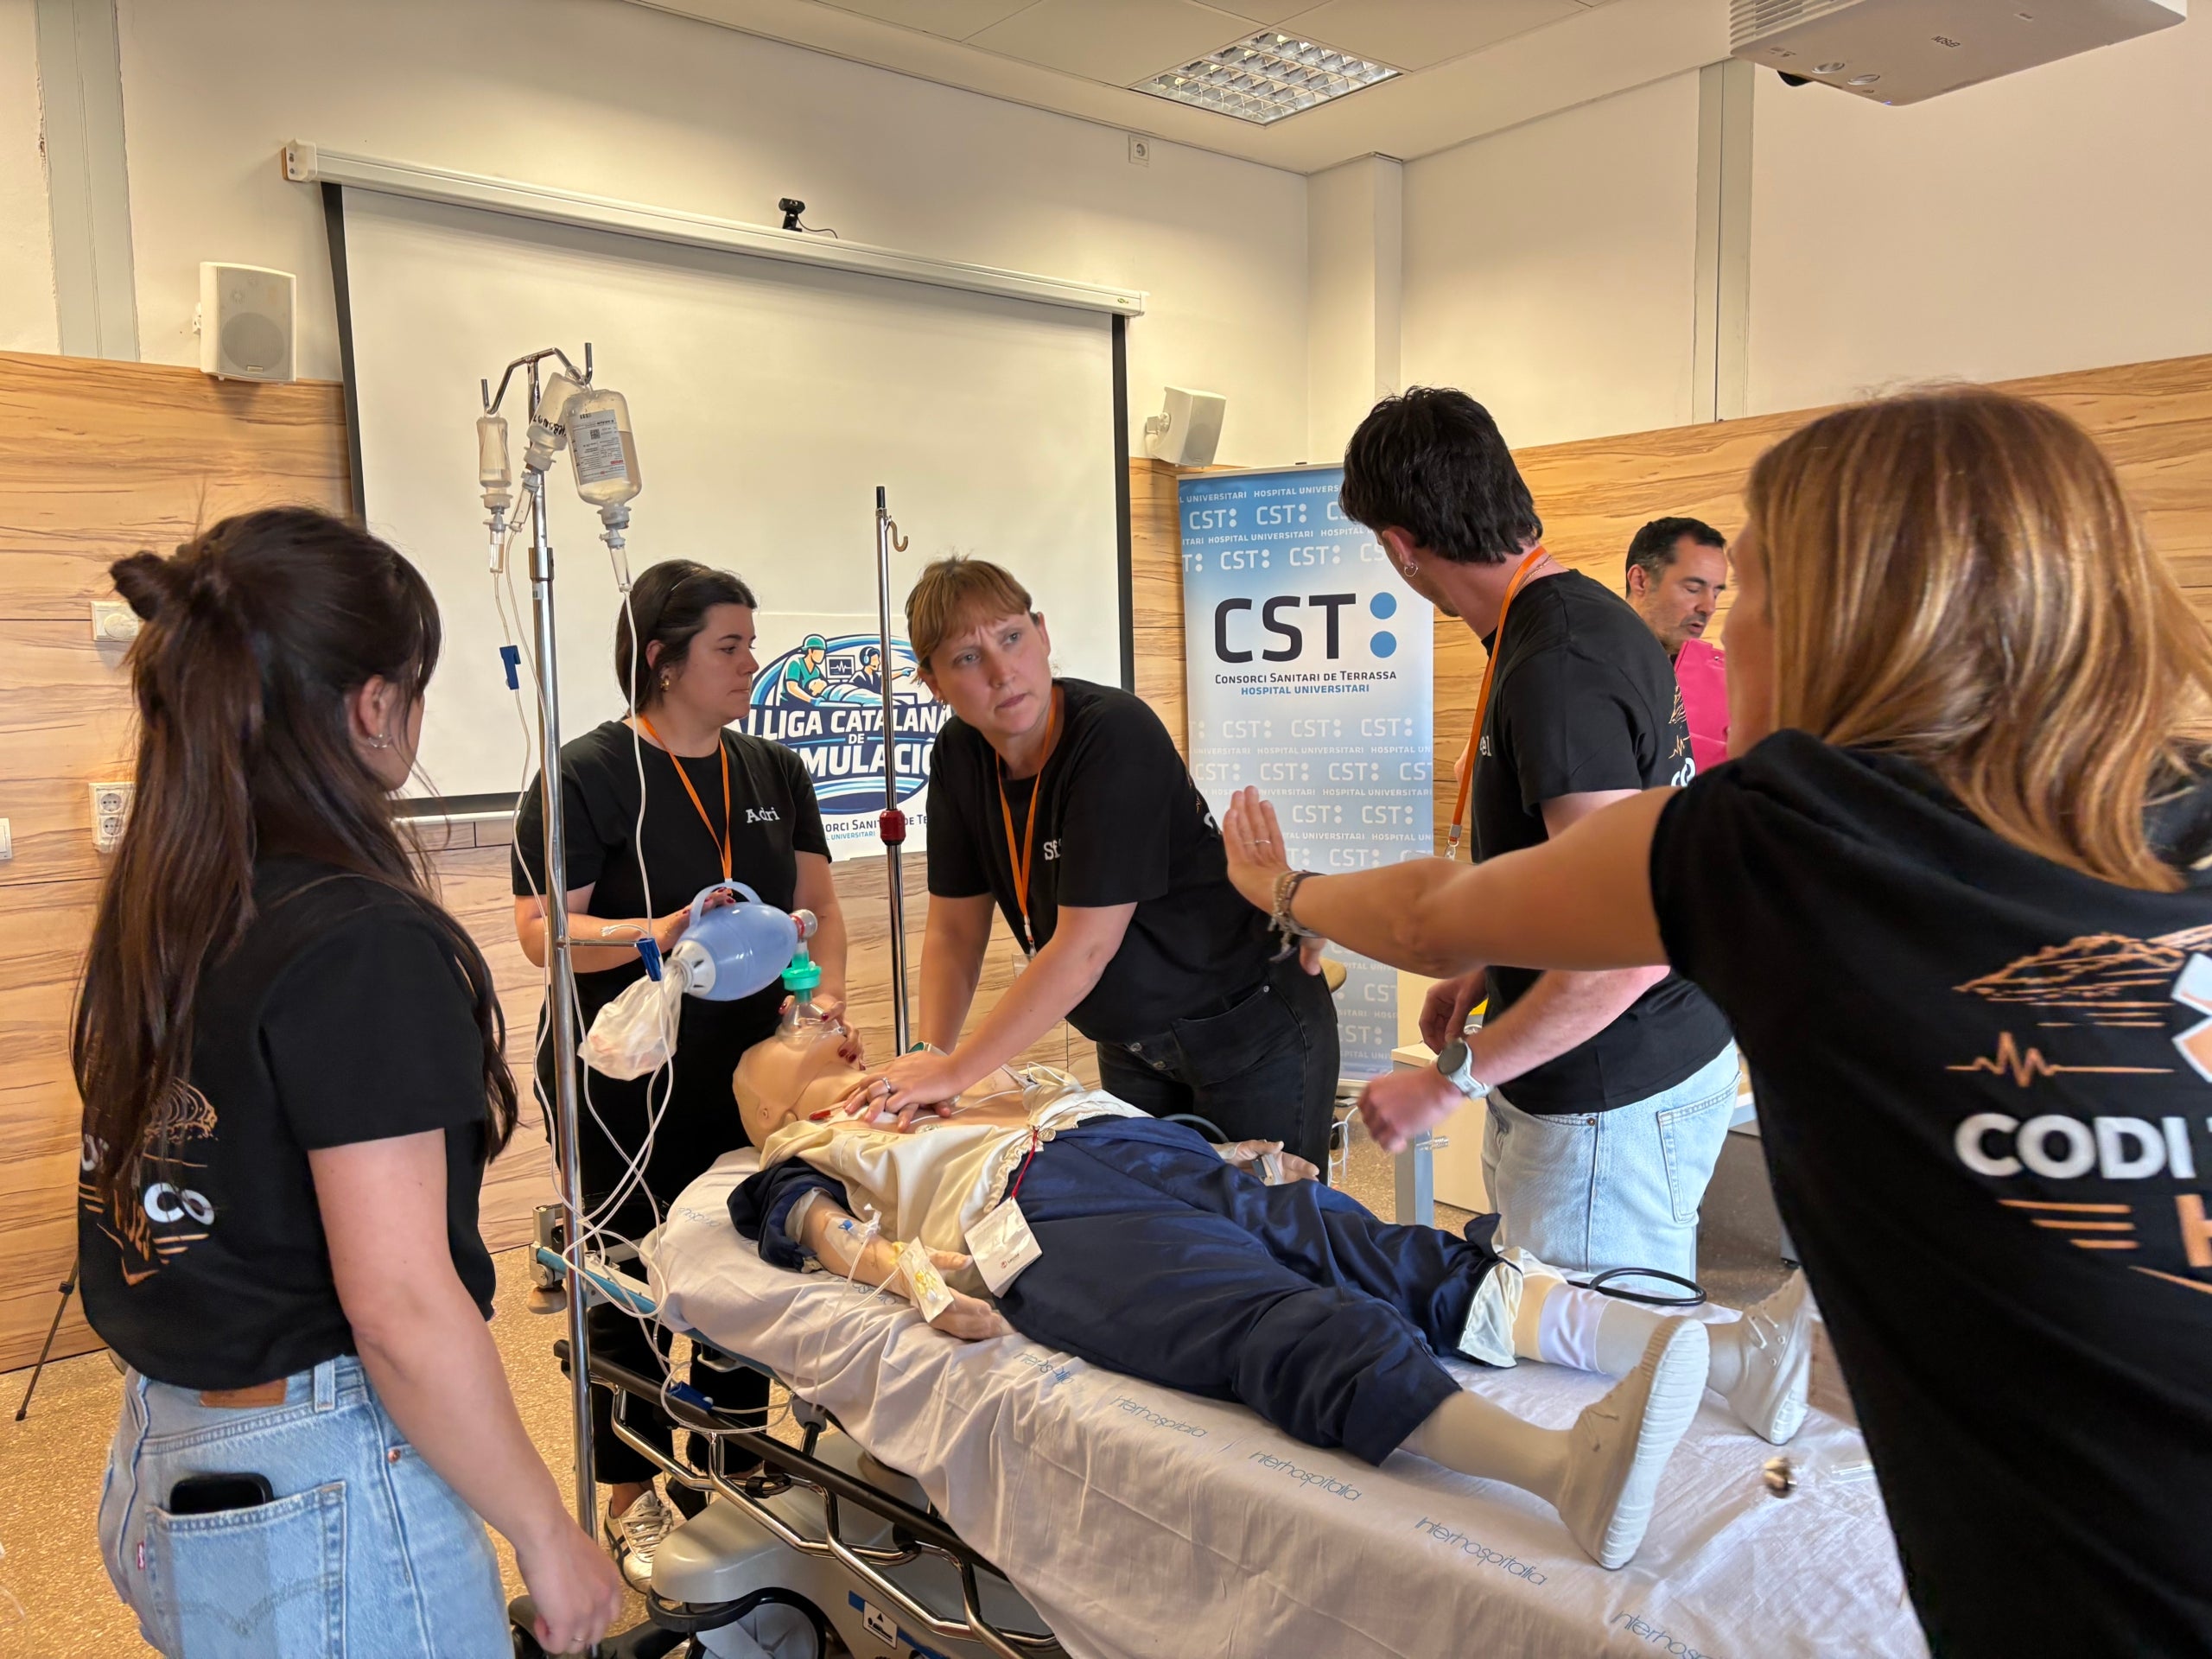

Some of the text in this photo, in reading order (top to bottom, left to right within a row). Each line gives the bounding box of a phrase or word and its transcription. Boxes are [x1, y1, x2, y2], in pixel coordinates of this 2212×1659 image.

[1187, 492, 1247, 502] UNIVERSITARI
[1254, 488, 1296, 498] HOSPITAL
[1299, 485, 1339, 494] UNIVERS
[1208, 535, 1249, 544] HOSPITAL
[1250, 531, 1313, 542] UNIVERSITARI
[1320, 527, 1363, 537] HOSPITAL
[1215, 674, 1266, 684] CONSORCI
[1269, 672, 1320, 683] SANITARI
[1339, 671, 1396, 681] TERRASSA
[1241, 684, 1370, 696] HOSPITAL UNIVERSITARI
[747, 709, 823, 741] LLIGA
[830, 704, 952, 734] CATALANA
[849, 734, 865, 745] DE
[790, 737, 933, 778] MULACI
[746, 806, 780, 823] Adri
[831, 831, 875, 841] UNIVERSITARI
[1302, 832, 1365, 841] UNIVERSITARI
[1955, 1113, 2196, 1179] CODI
